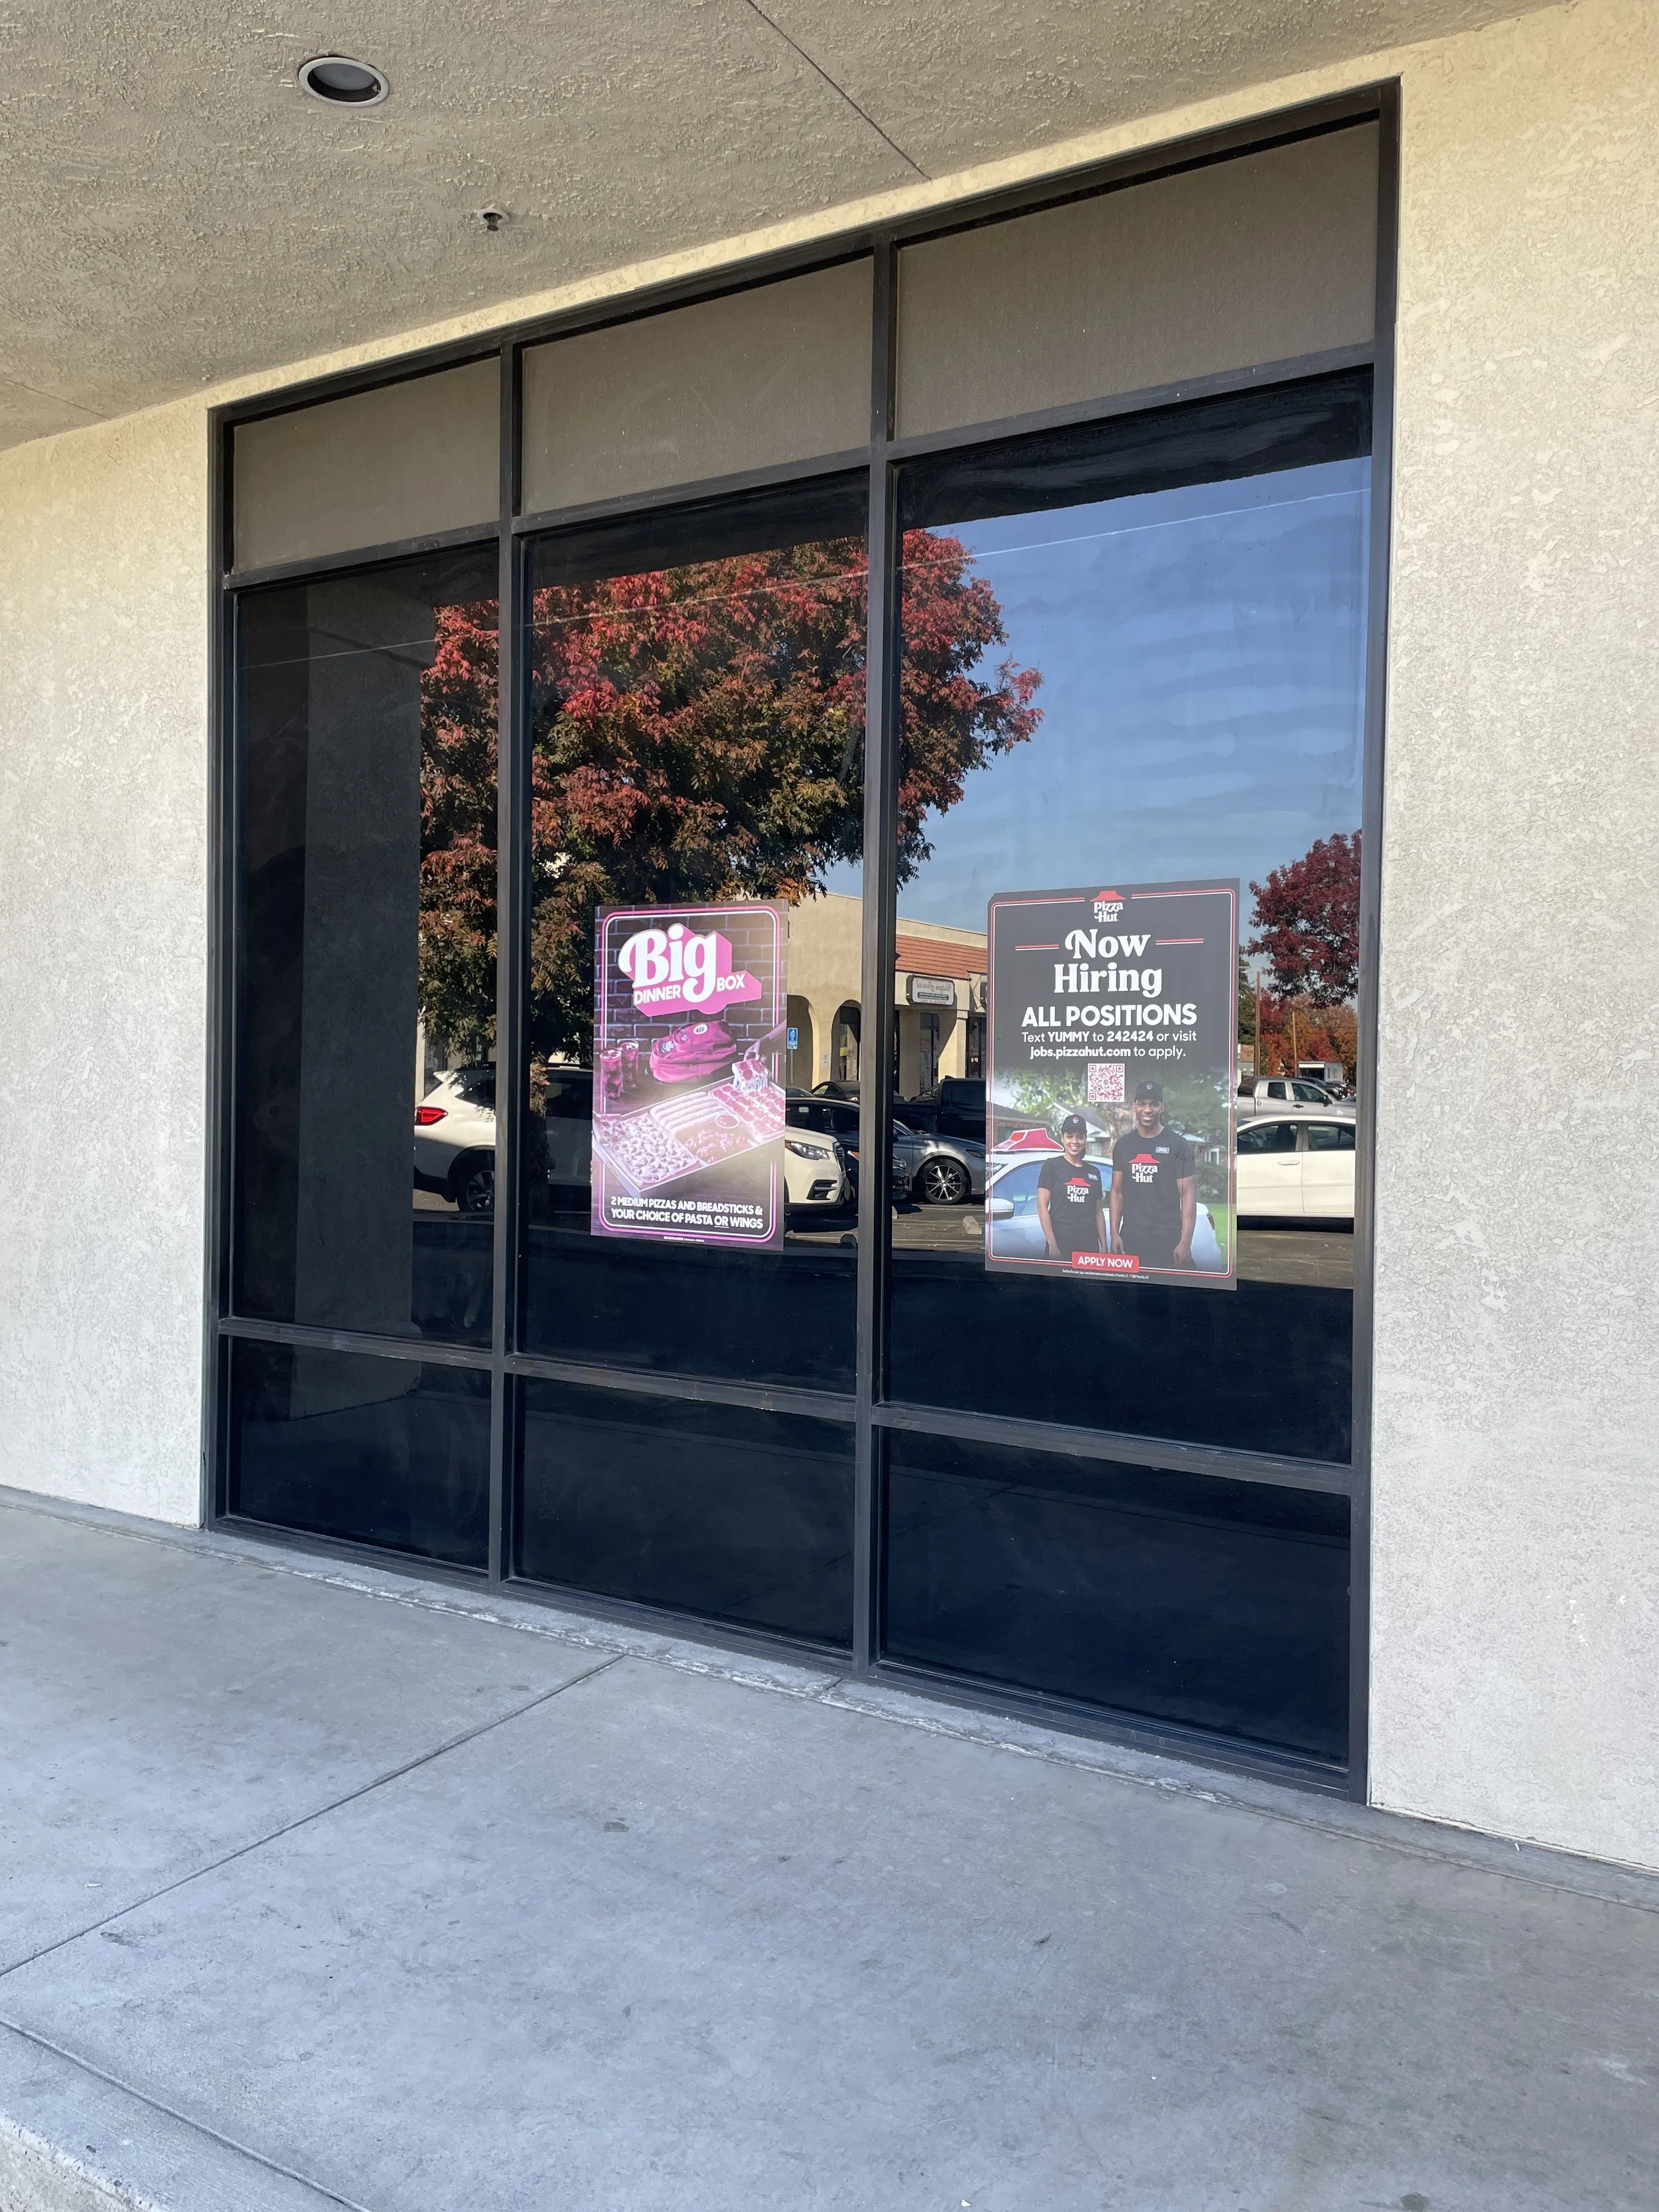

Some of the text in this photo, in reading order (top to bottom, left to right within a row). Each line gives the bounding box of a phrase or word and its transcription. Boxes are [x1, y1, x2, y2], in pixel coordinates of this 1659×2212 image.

[1094, 901, 1123, 913] Pizza
[1094, 911, 1119, 922] Hut
[1065, 928, 1151, 959] Now
[618, 922, 716, 1003] Big
[1054, 962, 1163, 997] Hiring
[634, 974, 745, 1004] DINNER BOX
[1021, 1003, 1198, 1027] ALL POSITIONS
[1022, 1030, 1197, 1043] Text YUMMY to 242424 or visit
[1029, 1045, 1187, 1059] jobs.pizzahut.com to apply.
[1131, 1163, 1158, 1174] Pizza
[1132, 1173, 1153, 1183] Hut
[1067, 1185, 1089, 1195] Pizza
[1067, 1194, 1085, 1203] Hut
[611, 1197, 763, 1215] 2 MEDIUM PIZZAS AND BREADSTICKS &
[611, 1209, 763, 1229] YOUR CHOICE OF PASTA OR WINGS
[1078, 1256, 1133, 1269] APPLY NOW
